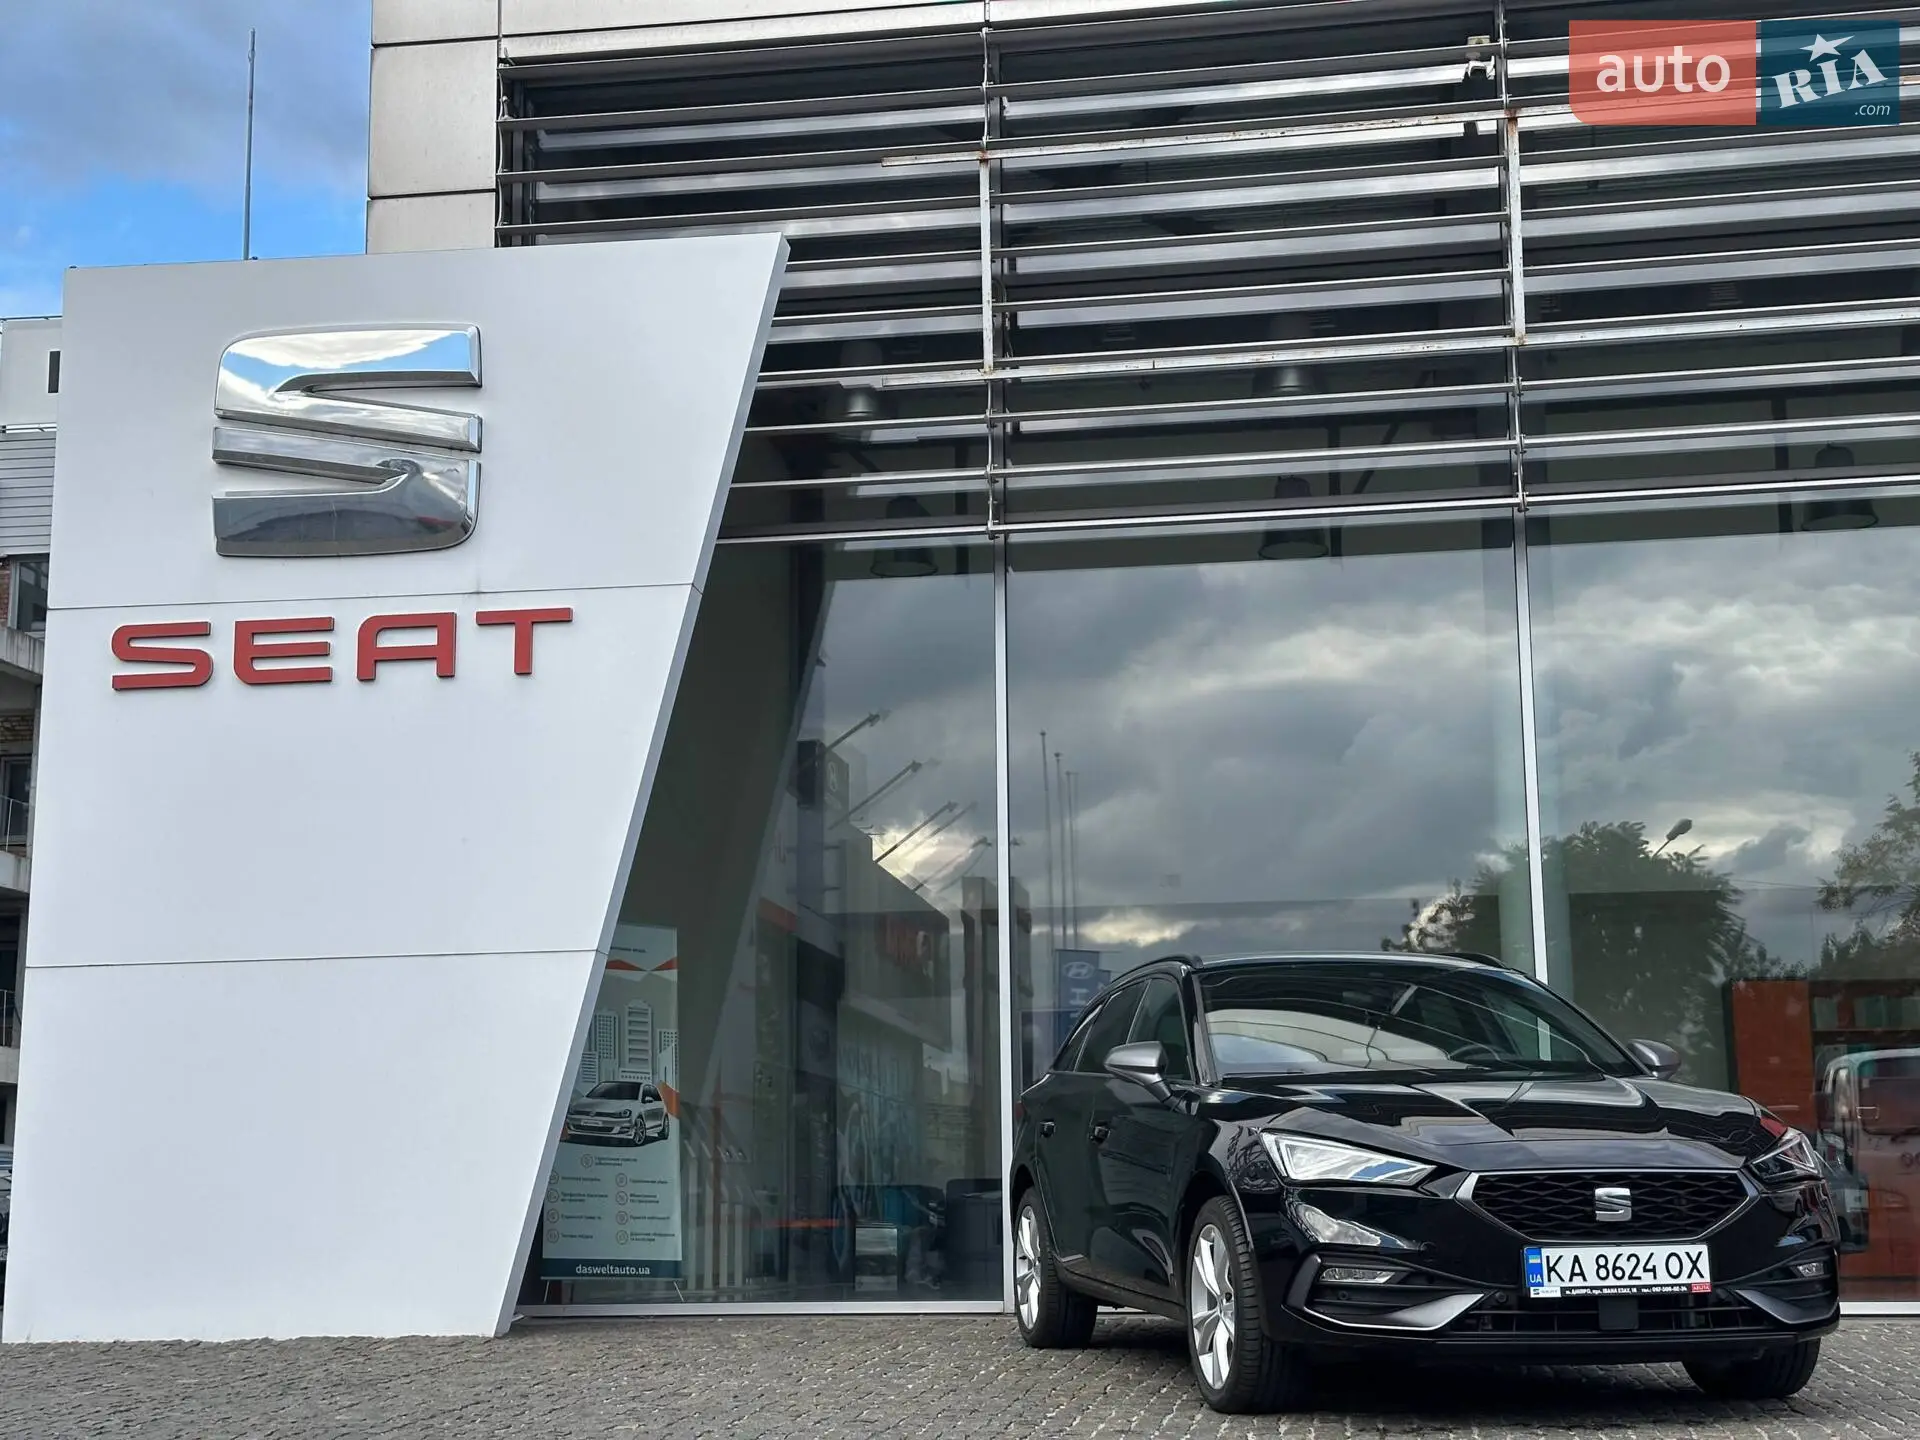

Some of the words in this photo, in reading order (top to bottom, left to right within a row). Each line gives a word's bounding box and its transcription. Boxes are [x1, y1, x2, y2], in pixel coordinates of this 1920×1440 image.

[111, 607, 573, 691] SEAT
[575, 1264, 651, 1275] dasweltauto.ua
[1546, 1254, 1588, 1283] KA
[1595, 1251, 1657, 1281] 8624
[1665, 1250, 1705, 1279] OX
[1529, 1273, 1543, 1283] UA
